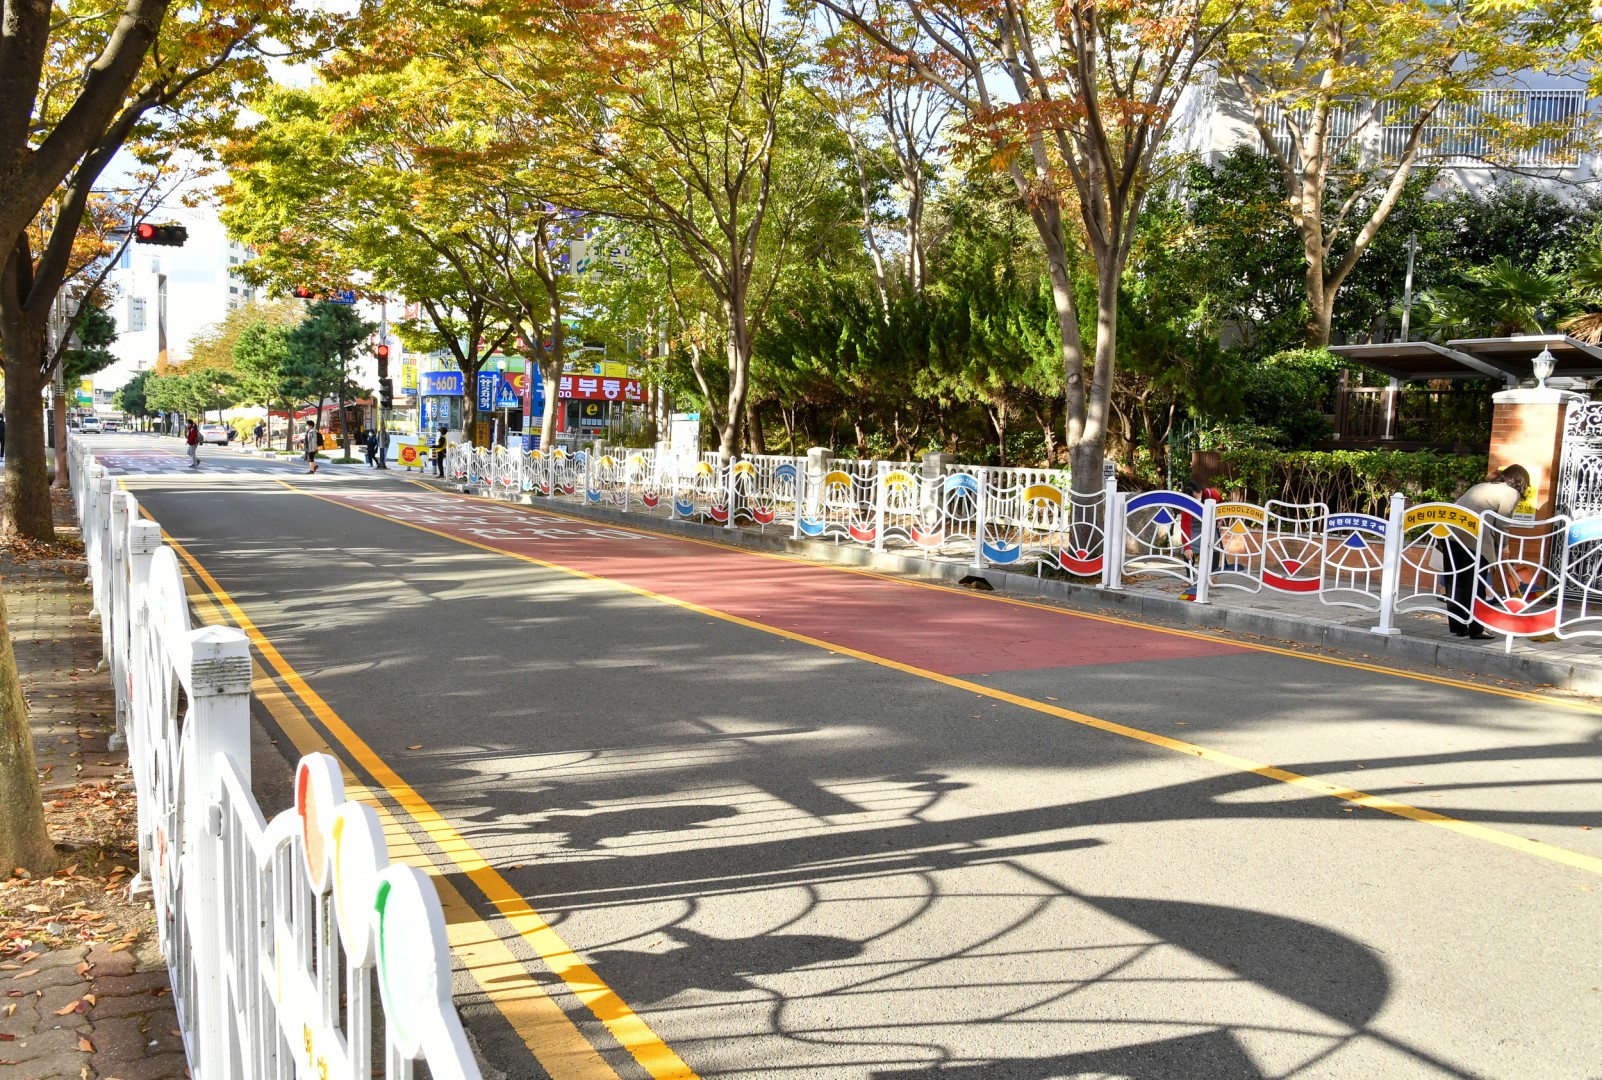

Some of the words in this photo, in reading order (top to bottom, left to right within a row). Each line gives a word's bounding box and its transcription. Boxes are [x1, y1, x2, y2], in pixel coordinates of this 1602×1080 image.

[578, 378, 642, 400] 부동산
[586, 403, 598, 416] e
[1217, 506, 1264, 519] SCHOOLZONE
[1407, 509, 1477, 530] 어린이보호구역
[1328, 517, 1386, 533] 어린이보호구역
[459, 527, 659, 540] 천천히
